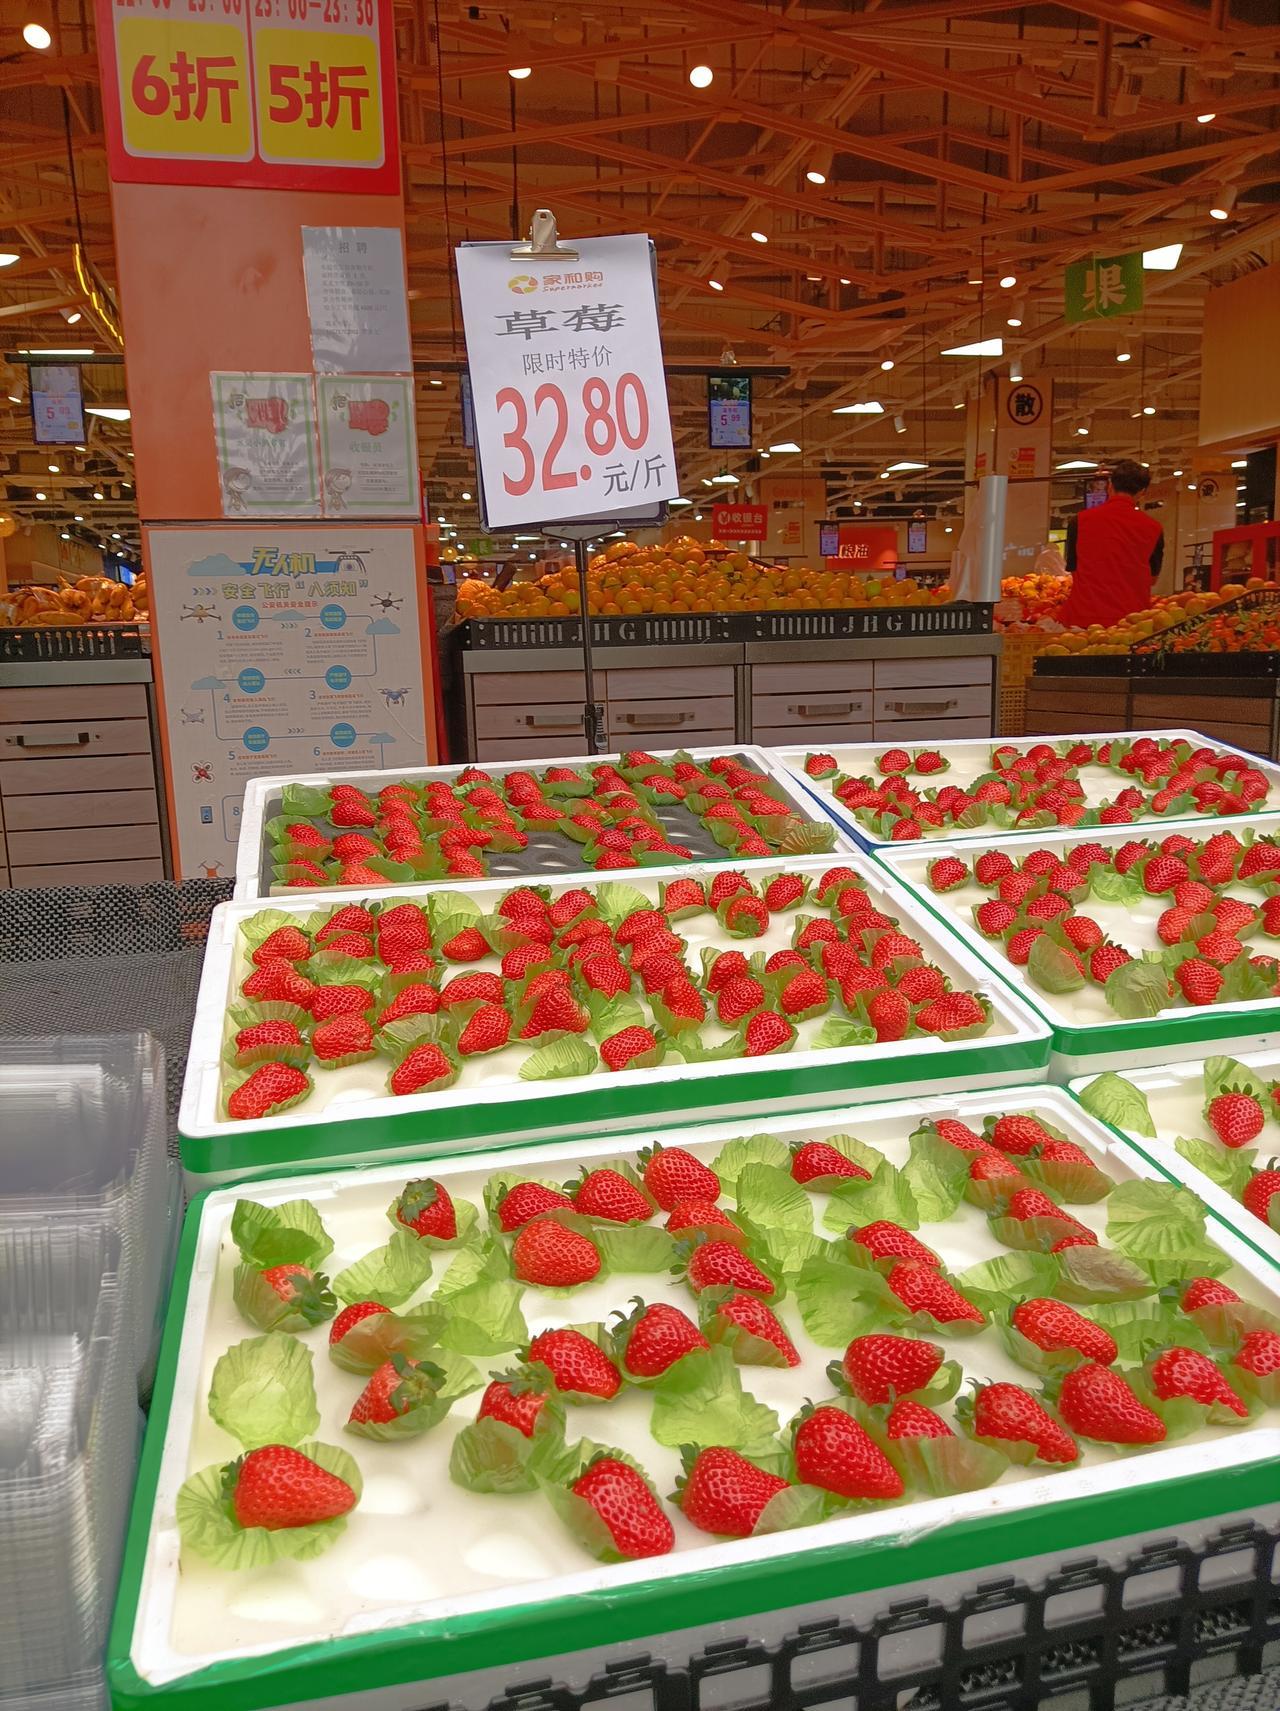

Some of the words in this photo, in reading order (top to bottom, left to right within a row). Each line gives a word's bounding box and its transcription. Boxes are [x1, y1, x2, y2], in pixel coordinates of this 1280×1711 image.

[131, 51, 239, 123] 6折
[268, 61, 369, 131] 5折
[543, 271, 604, 286] 家和购
[494, 303, 627, 340] 草莓
[522, 344, 612, 376] 限时特价
[1015, 393, 1036, 417] 散
[495, 372, 650, 496] 32.80
[602, 454, 667, 496] 元/斤
[732, 512, 764, 525] 收银台
[251, 546, 316, 578] 无人机
[217, 631, 224, 640] 1
[304, 628, 312, 638] 2
[223, 694, 231, 703] 4
[309, 690, 316, 700] 3
[228, 750, 236, 760] 5
[313, 746, 321, 756] 6
